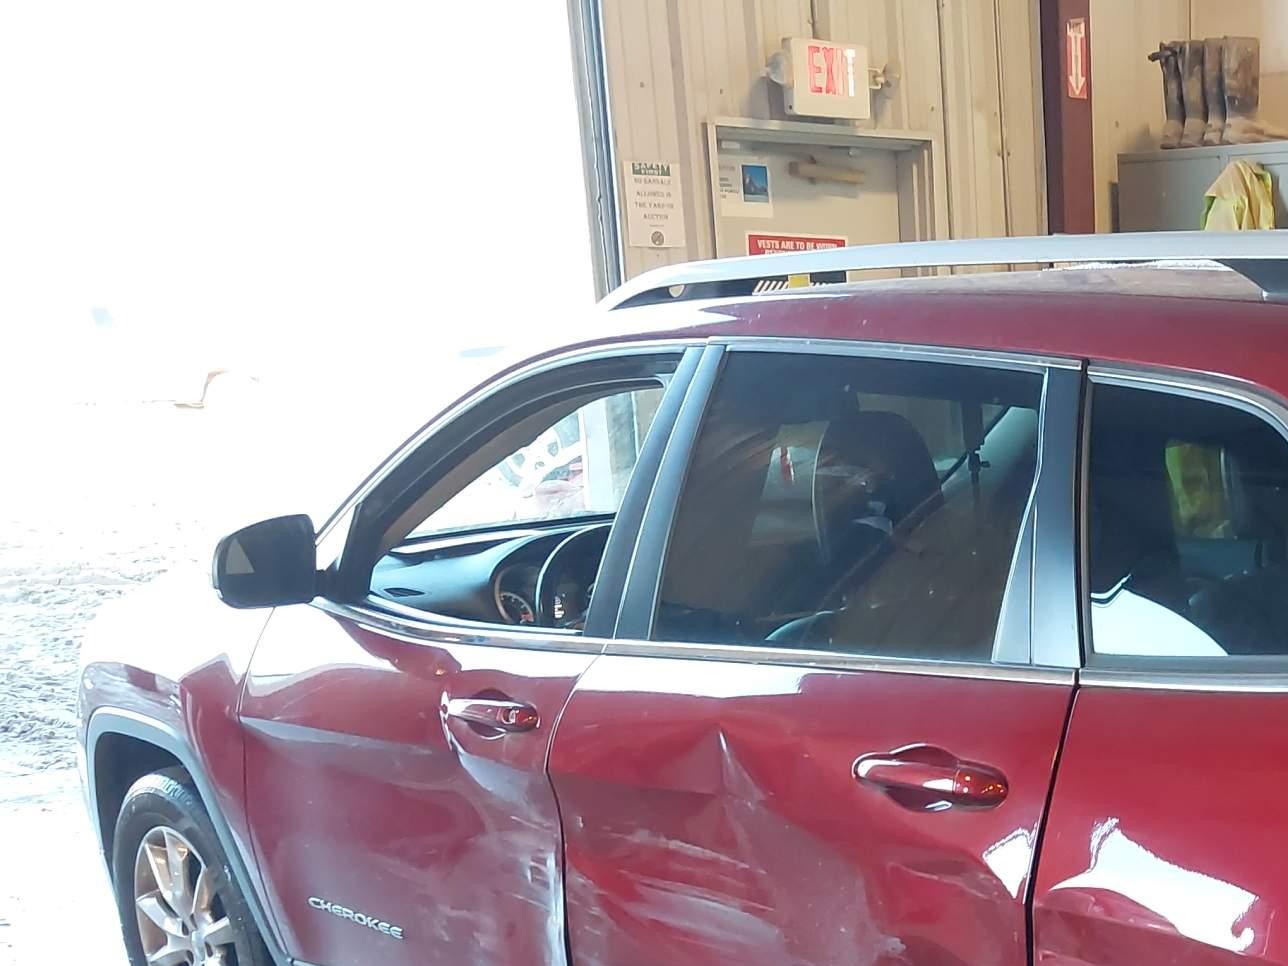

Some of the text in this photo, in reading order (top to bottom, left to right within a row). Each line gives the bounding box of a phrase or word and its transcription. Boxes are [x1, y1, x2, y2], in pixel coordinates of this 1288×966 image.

[807, 46, 856, 96] EXIT
[757, 239, 780, 249] VESTS
[781, 240, 794, 250] ARE
[796, 242, 805, 250] TO
[307, 896, 404, 940] CHEROKEE
